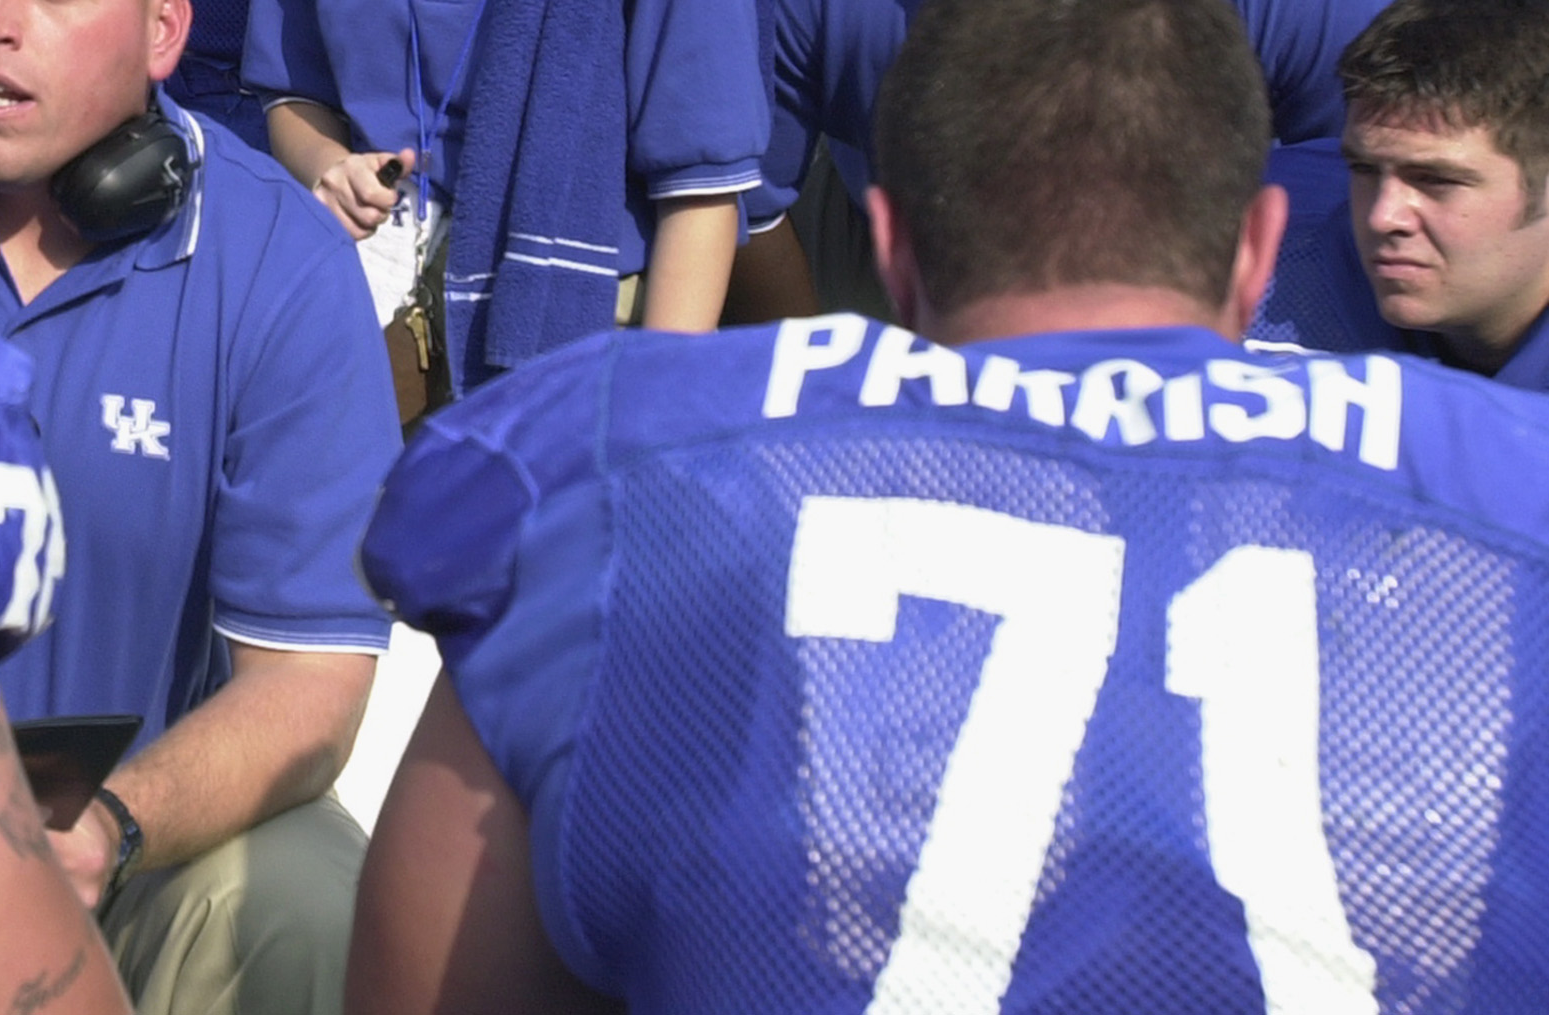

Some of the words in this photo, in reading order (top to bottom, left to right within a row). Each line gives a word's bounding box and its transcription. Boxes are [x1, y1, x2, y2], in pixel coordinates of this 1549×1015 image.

[101, 394, 171, 461] UK
[762, 313, 1402, 471] PARRISH
[784, 494, 1379, 1015] 71
